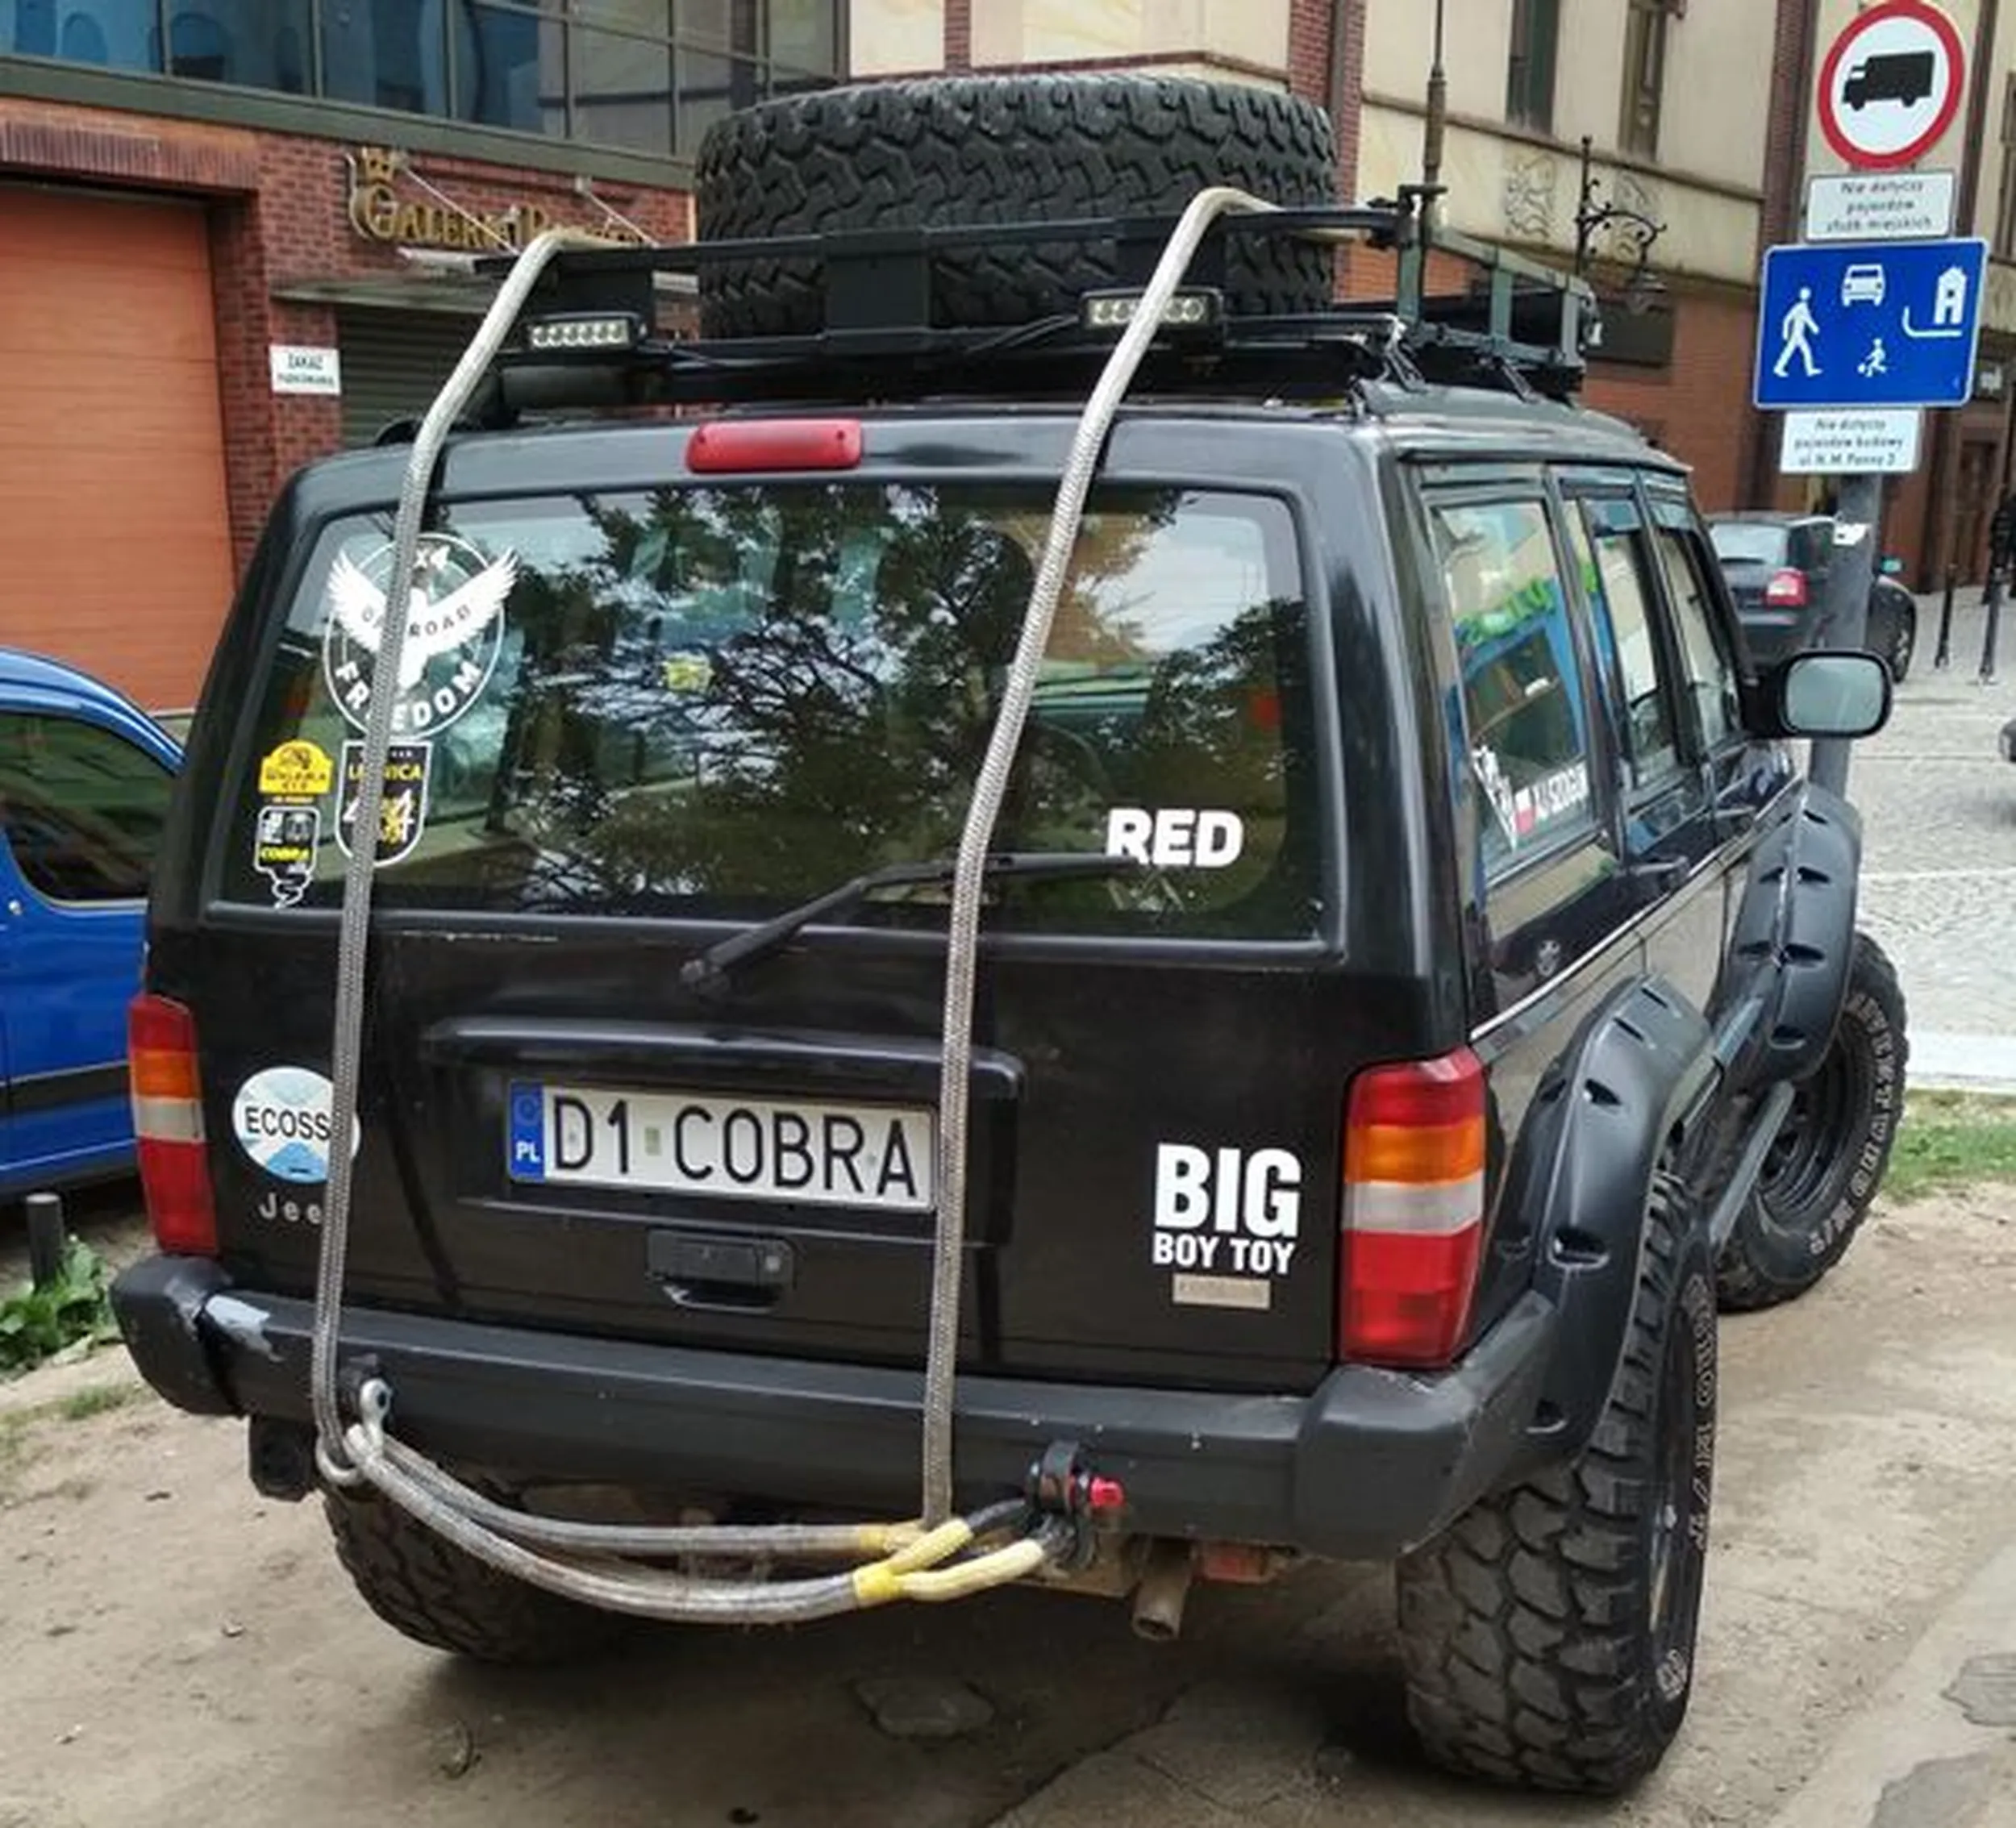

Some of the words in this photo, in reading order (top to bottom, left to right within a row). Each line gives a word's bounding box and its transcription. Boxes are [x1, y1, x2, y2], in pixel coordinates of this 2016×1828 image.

[335, 660, 481, 731] FREDOM
[1106, 808, 1244, 868] RED
[244, 1106, 332, 1141] ECOSS
[554, 1096, 629, 1175] D1
[673, 1106, 918, 1198] COBRA
[515, 1141, 541, 1164] PL
[258, 1192, 323, 1226] Jee
[1155, 1143, 1302, 1239] BIG
[1152, 1232, 1221, 1268] BOY
[1229, 1237, 1295, 1275] TOY
